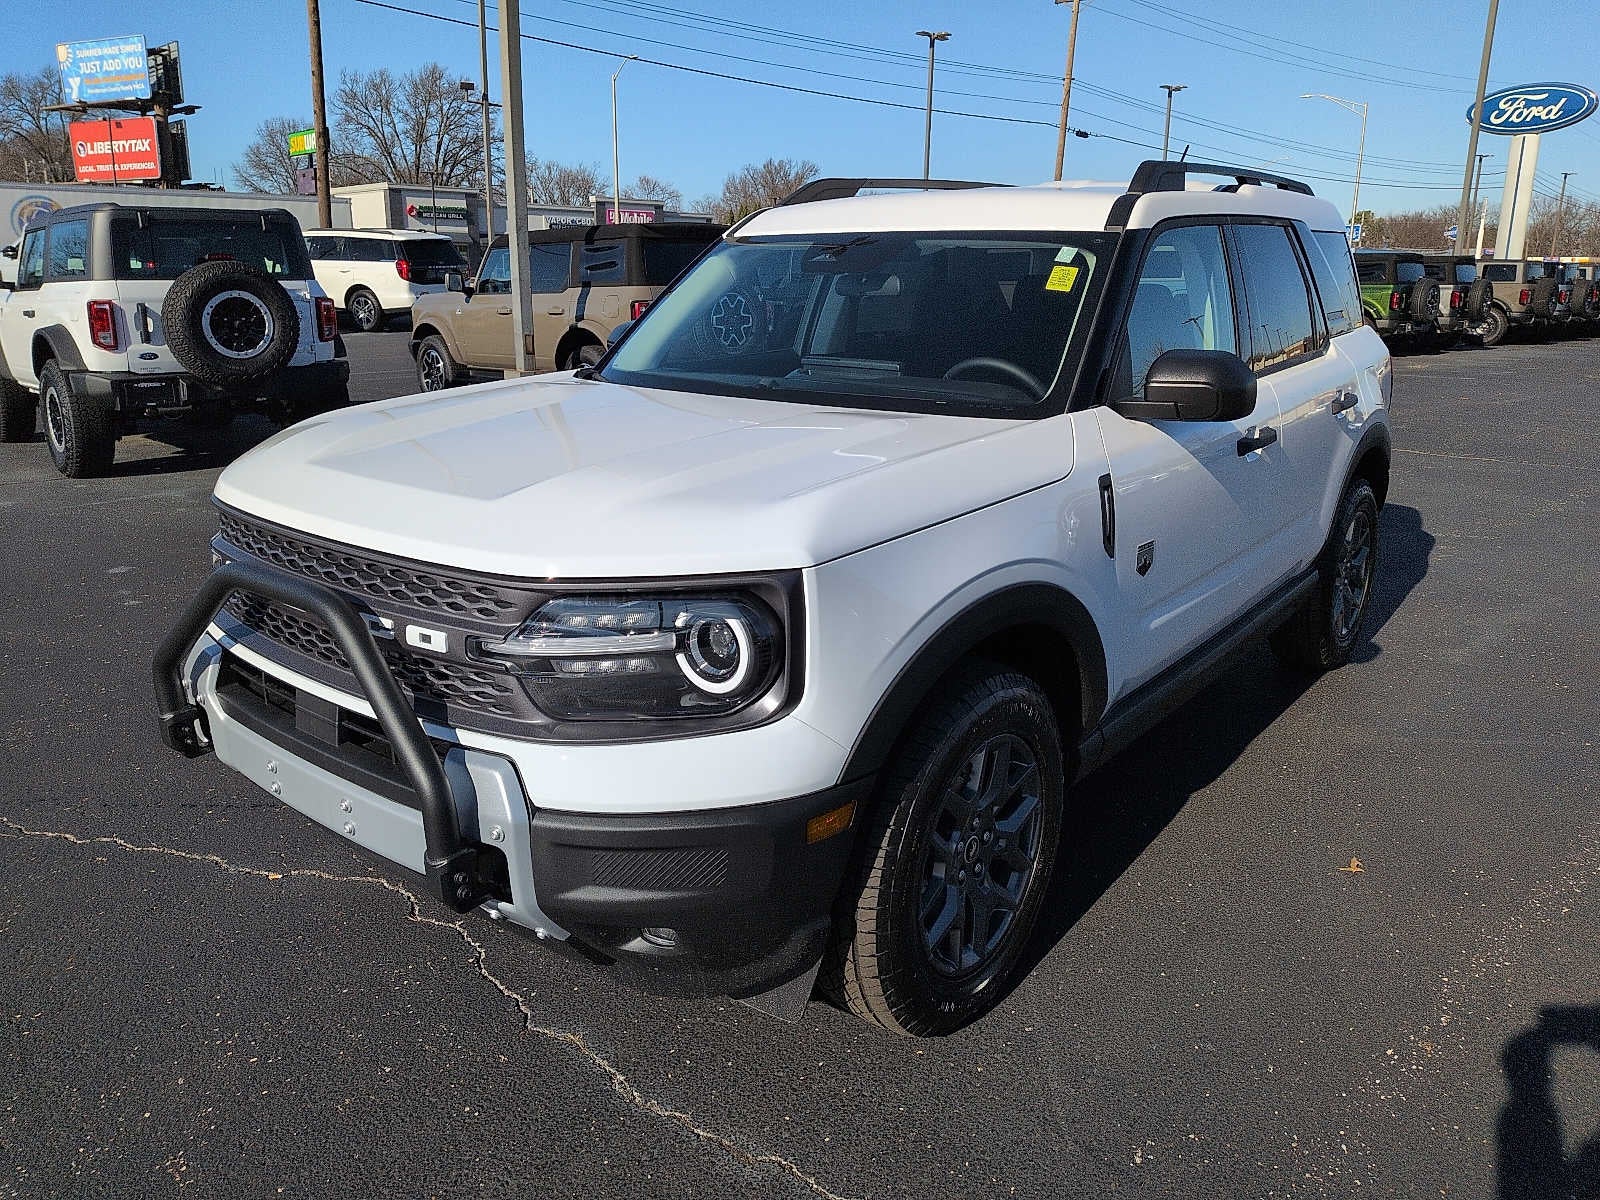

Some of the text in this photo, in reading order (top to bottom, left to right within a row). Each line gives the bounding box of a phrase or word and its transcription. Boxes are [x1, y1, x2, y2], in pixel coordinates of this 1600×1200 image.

[79, 56, 142, 74] JUST ADD YOU
[1490, 92, 1567, 125] Ford
[291, 133, 317, 153] SUBWA
[96, 163, 120, 172] TRUSTD.
[120, 161, 156, 171] EXPERIENCED.
[547, 215, 592, 226] VAPOR CBD
